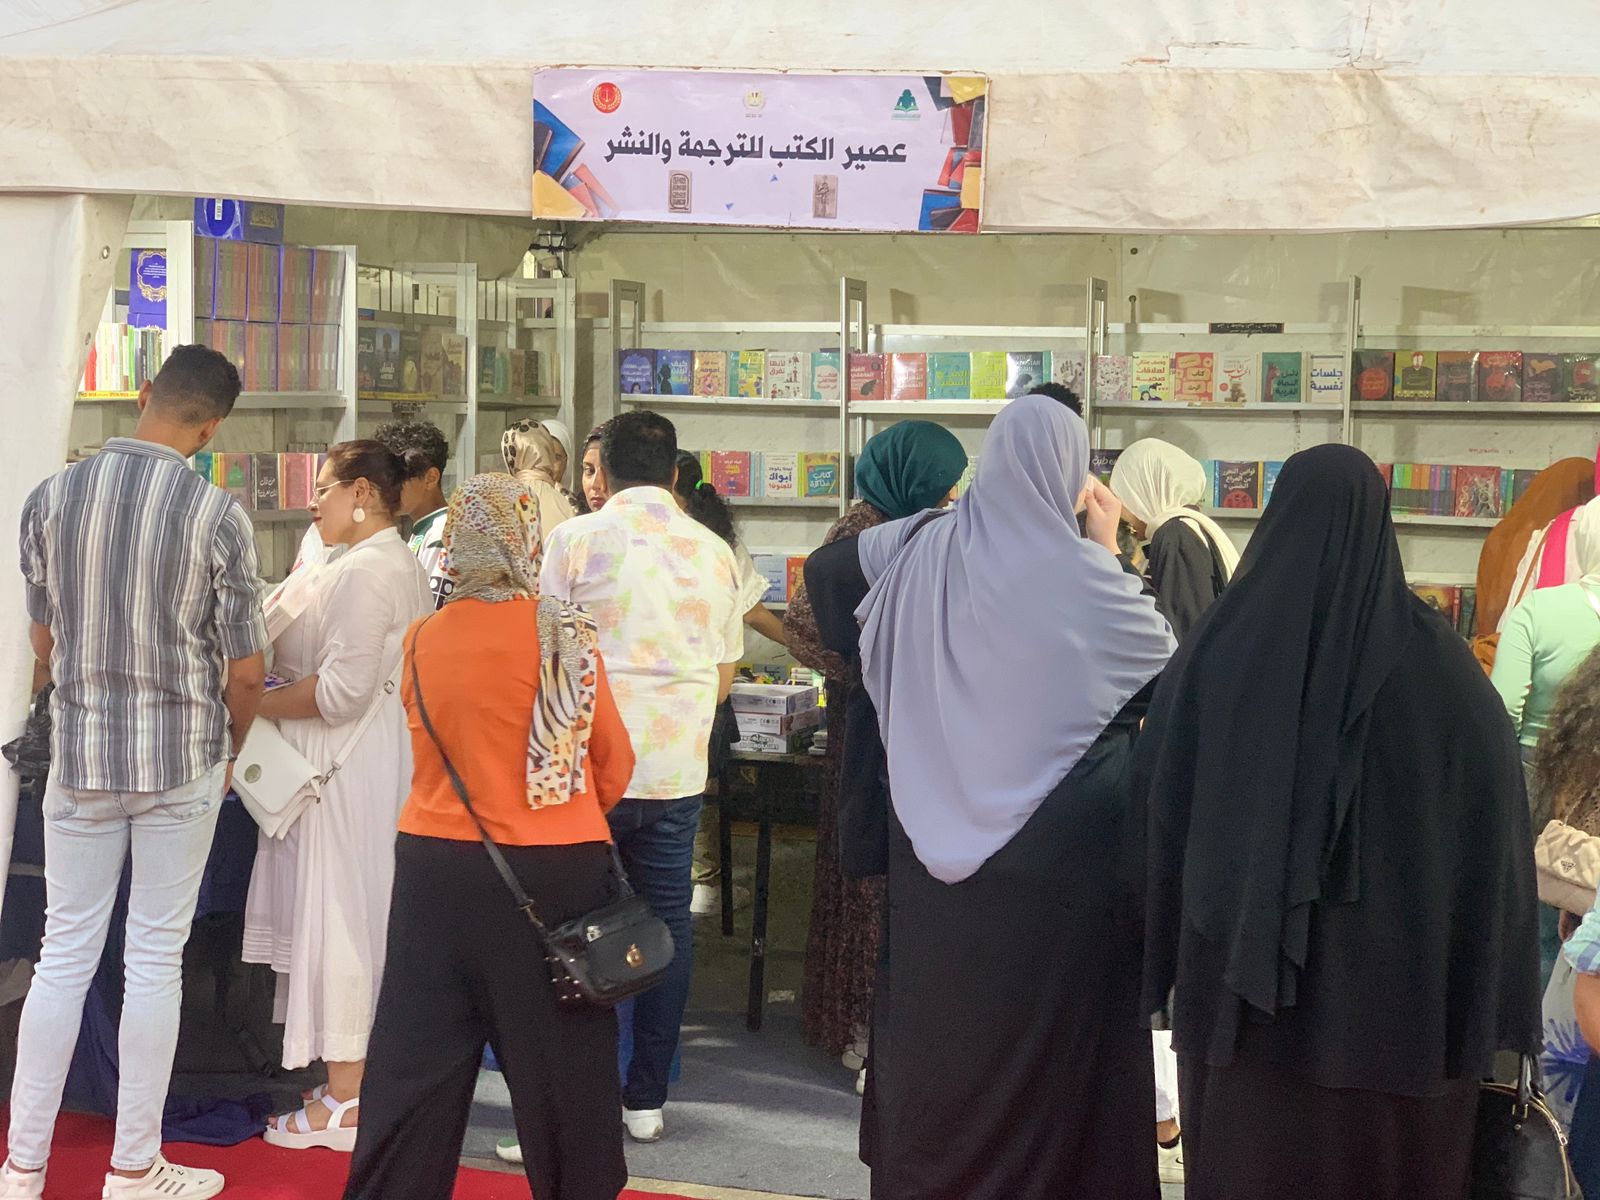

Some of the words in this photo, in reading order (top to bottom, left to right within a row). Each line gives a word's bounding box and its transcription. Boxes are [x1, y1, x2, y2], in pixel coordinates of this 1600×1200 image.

[604, 126, 672, 164] والنشر
[678, 130, 763, 166] للترجمة
[769, 134, 834, 168] الكتب
[841, 141, 907, 170] عصير
[1310, 367, 1344, 380] جلسات
[1310, 380, 1344, 393] نفسية
